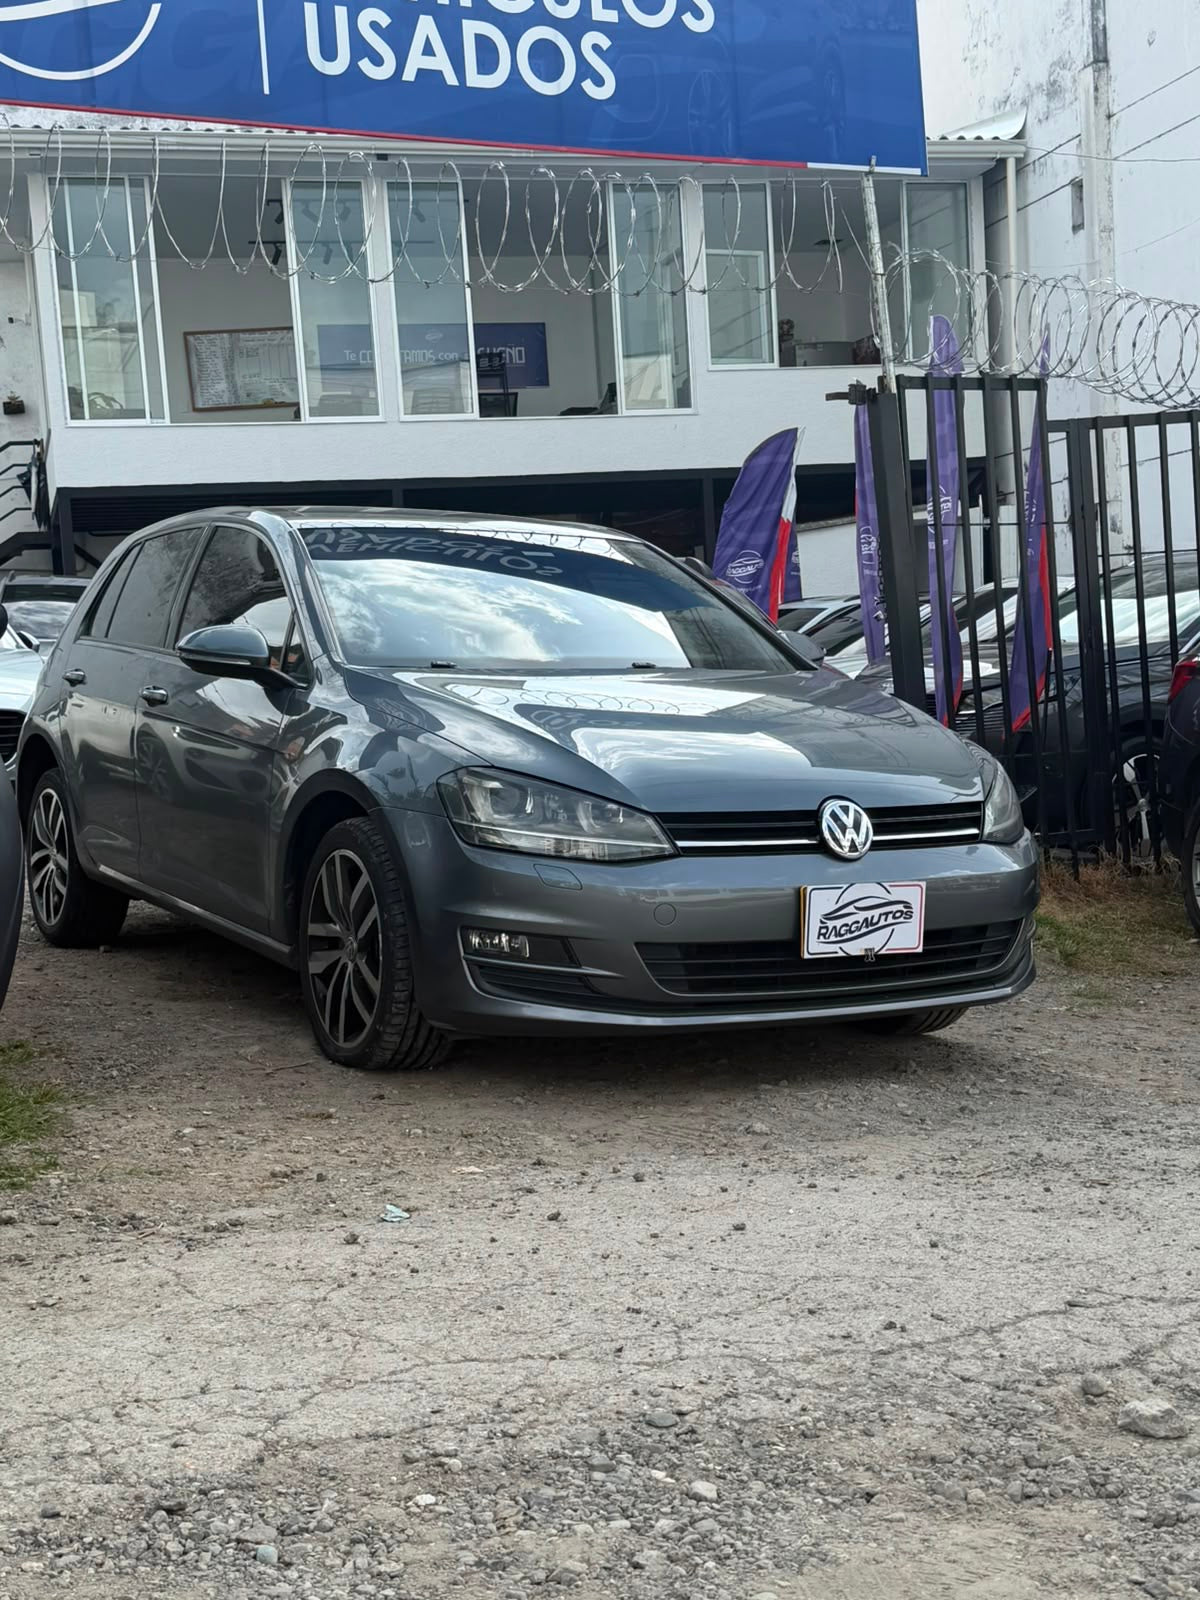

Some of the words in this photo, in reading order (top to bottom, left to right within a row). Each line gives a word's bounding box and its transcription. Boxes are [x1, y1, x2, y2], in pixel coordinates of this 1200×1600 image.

[304, 2, 616, 100] USADOS
[822, 799, 874, 858] VW
[816, 908, 914, 941] RAGGAUTOS
